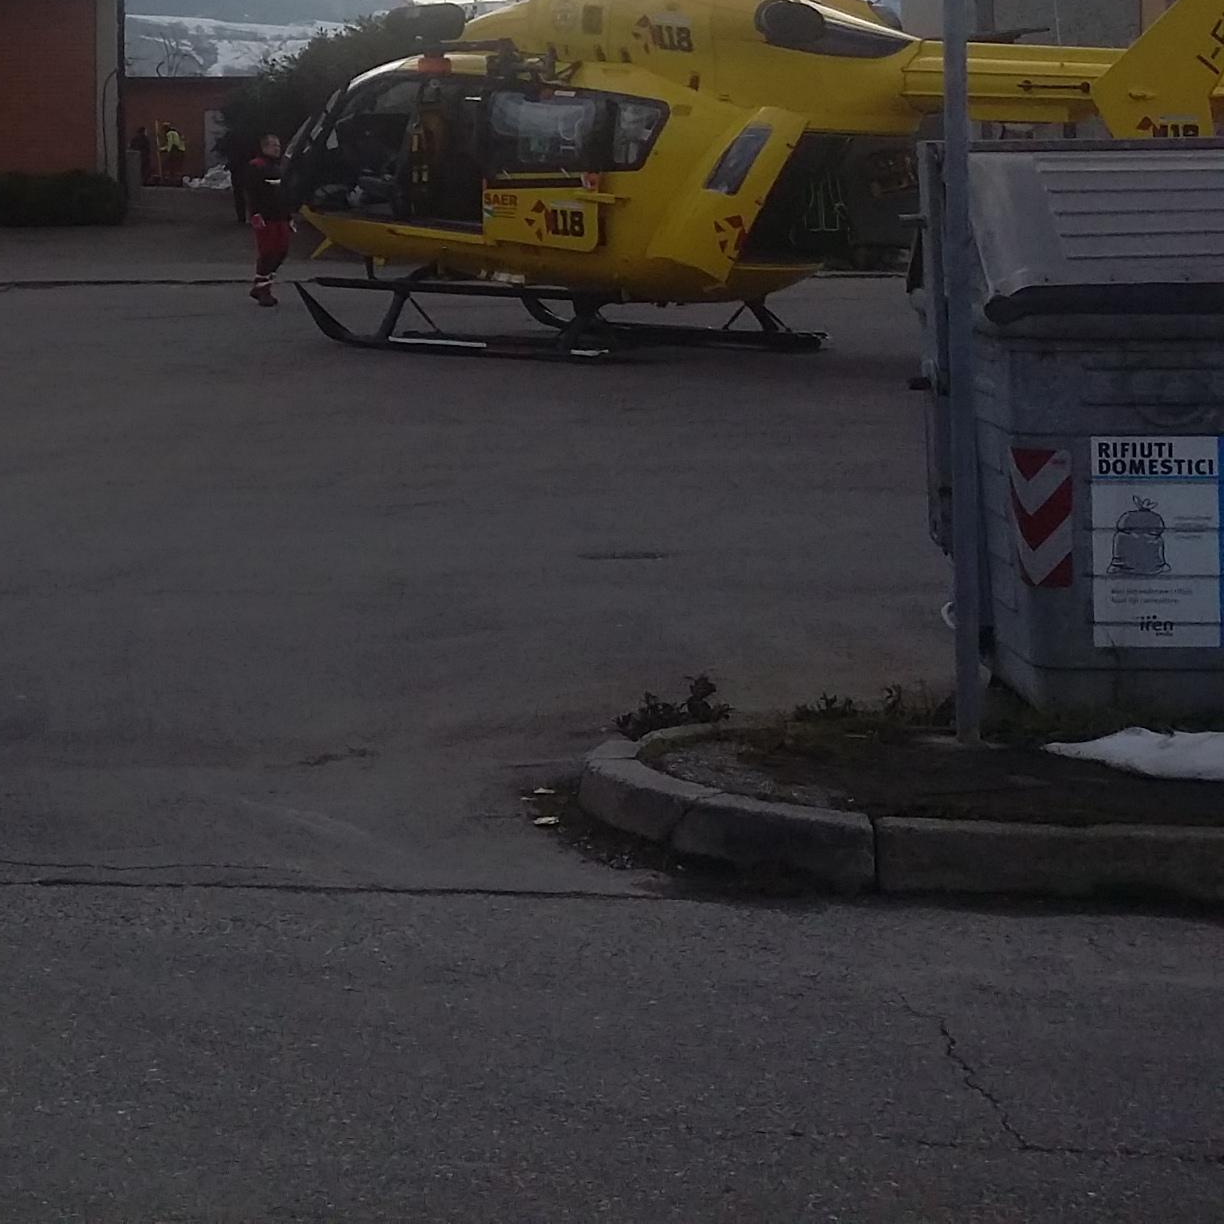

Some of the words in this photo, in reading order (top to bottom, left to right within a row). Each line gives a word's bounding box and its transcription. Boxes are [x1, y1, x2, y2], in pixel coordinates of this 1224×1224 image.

[655, 25, 694, 53] 118
[483, 194, 518, 207] SAER
[550, 210, 585, 237] 118
[1097, 442, 1174, 458] RIFIUTI
[1097, 458, 1215, 475] DOMESTICI
